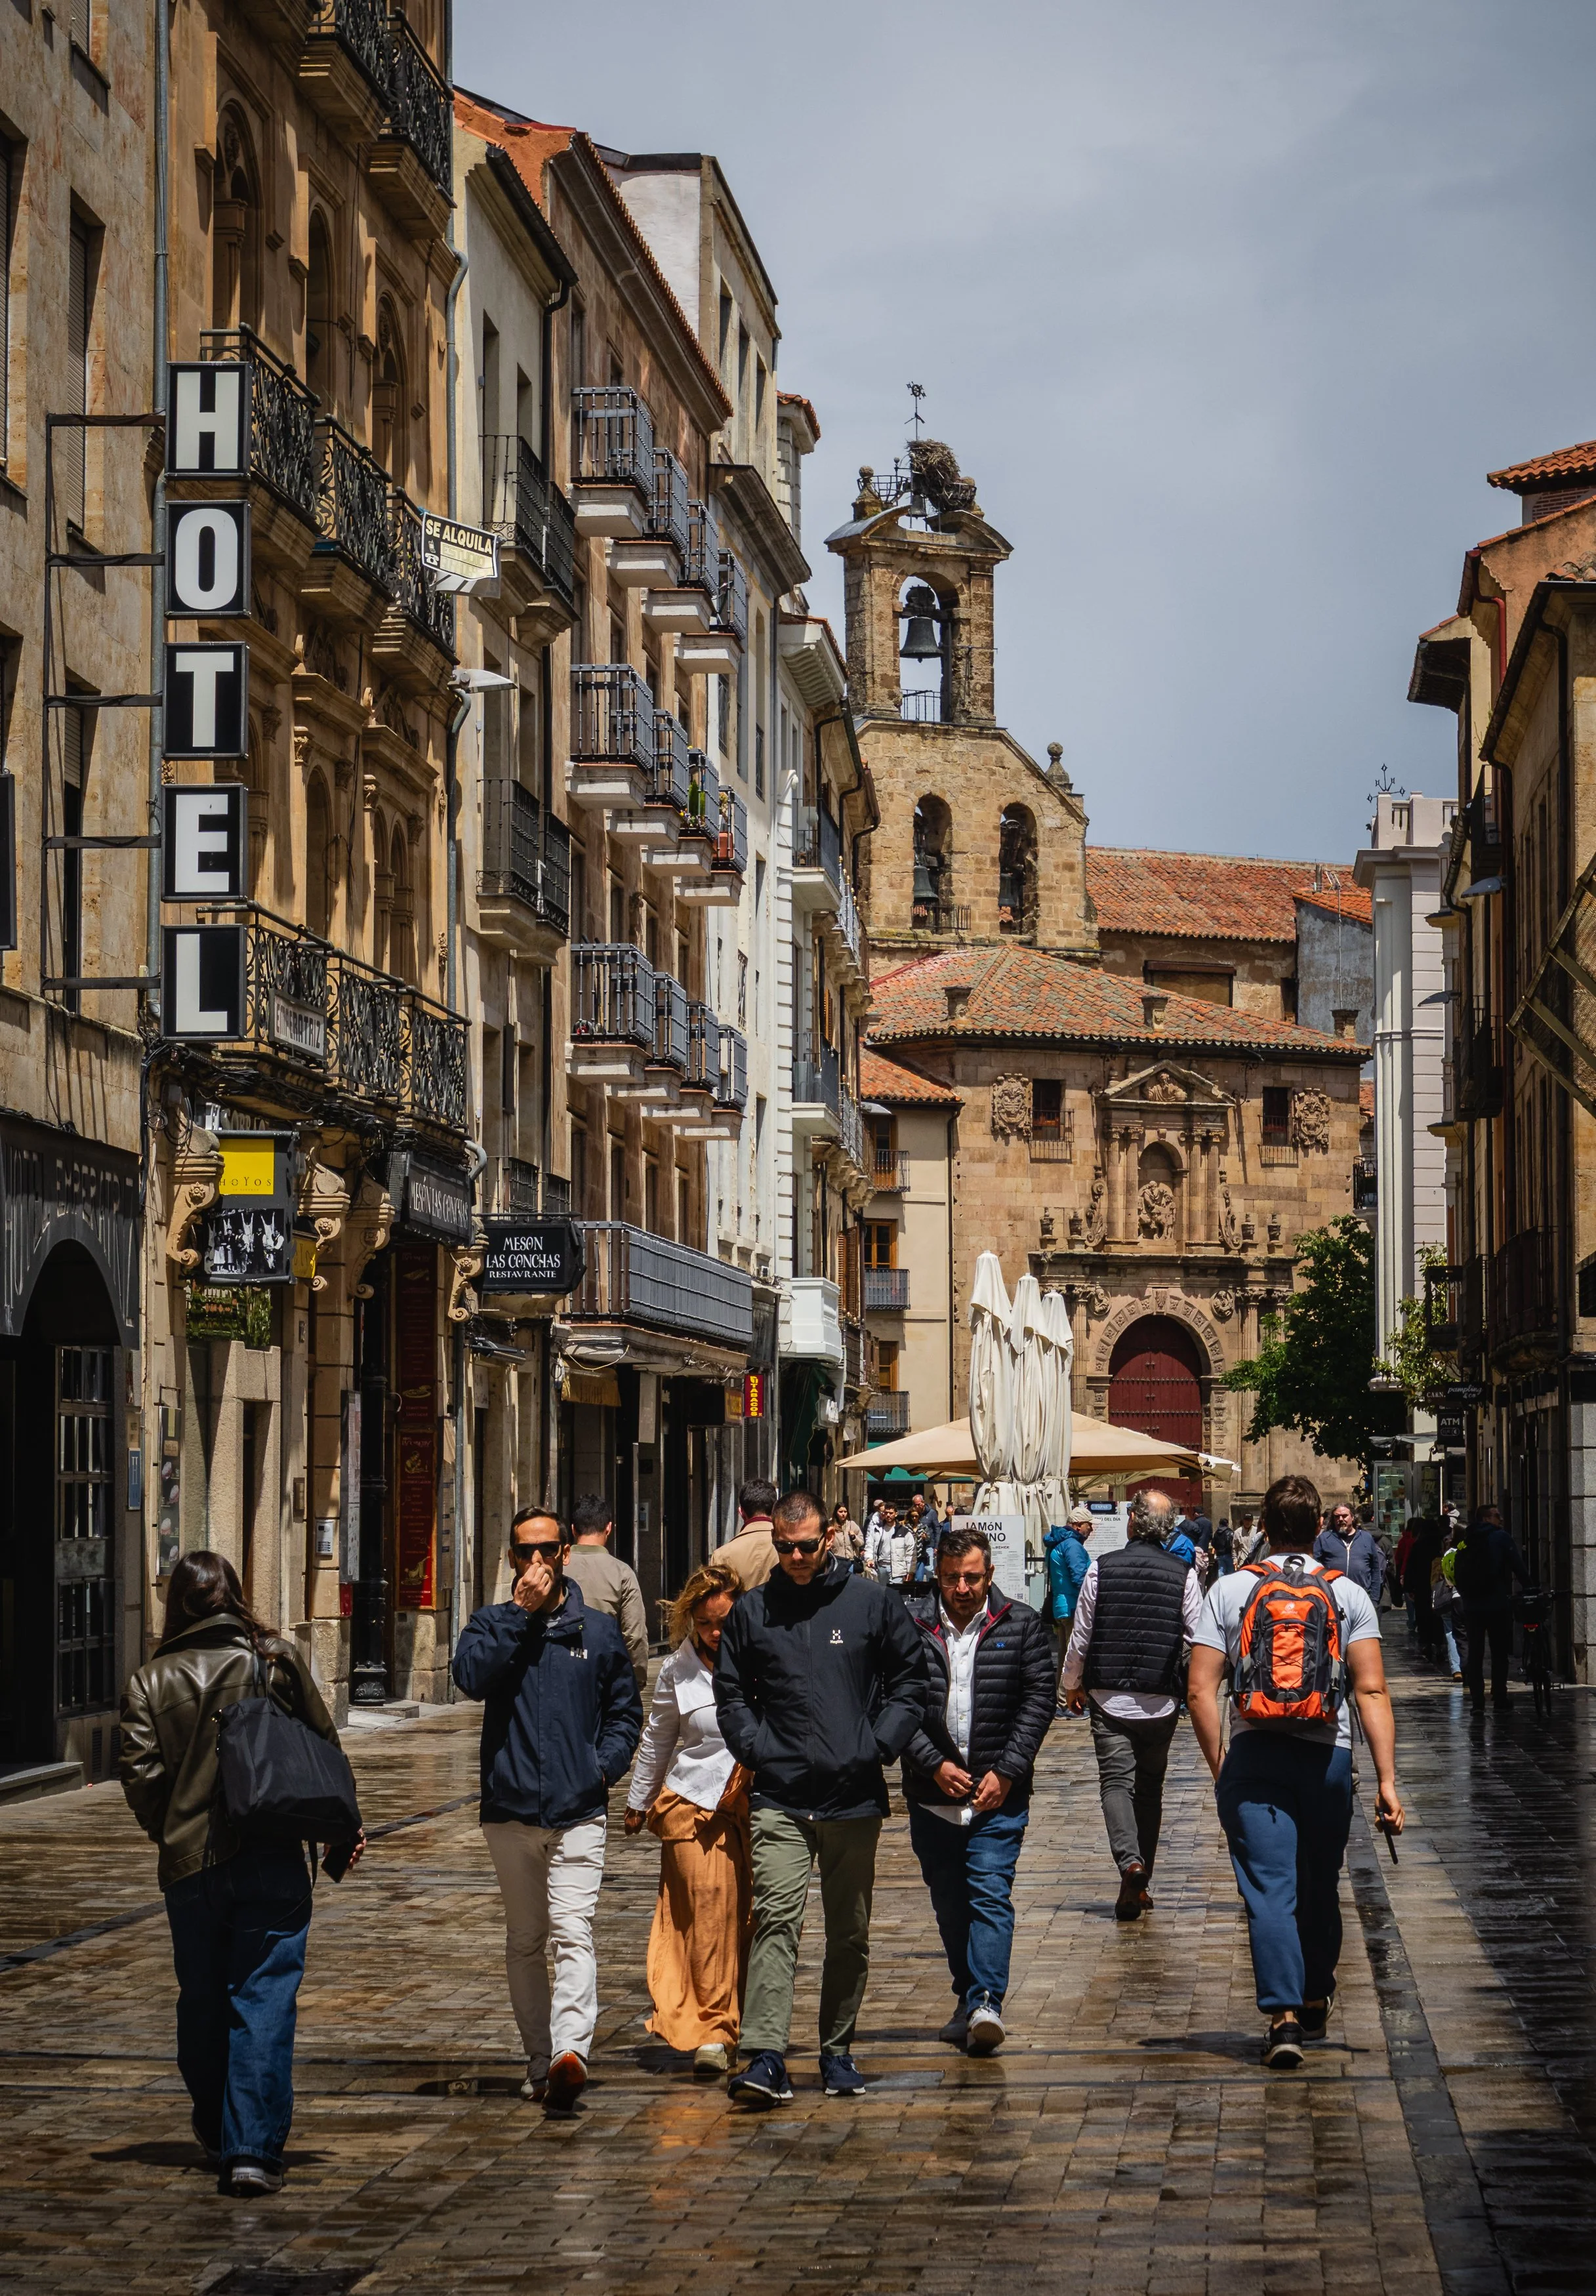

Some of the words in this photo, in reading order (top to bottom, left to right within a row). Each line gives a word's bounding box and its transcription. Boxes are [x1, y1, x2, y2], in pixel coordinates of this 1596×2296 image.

[426, 519, 441, 538] SE
[442, 525, 493, 555] ALQUILA
[174, 371, 240, 1033] HOTEL
[218, 1176, 272, 1186] HOYOS
[432, 1188, 442, 1220] LAS
[443, 1193, 469, 1231] CONCHAS
[503, 1236, 543, 1251] MESON
[486, 1254, 505, 1269] LAS
[508, 1254, 561, 1269] CONCHAS
[750, 1383, 758, 1417] TABACOS
[1447, 1384, 1483, 1395] pampling
